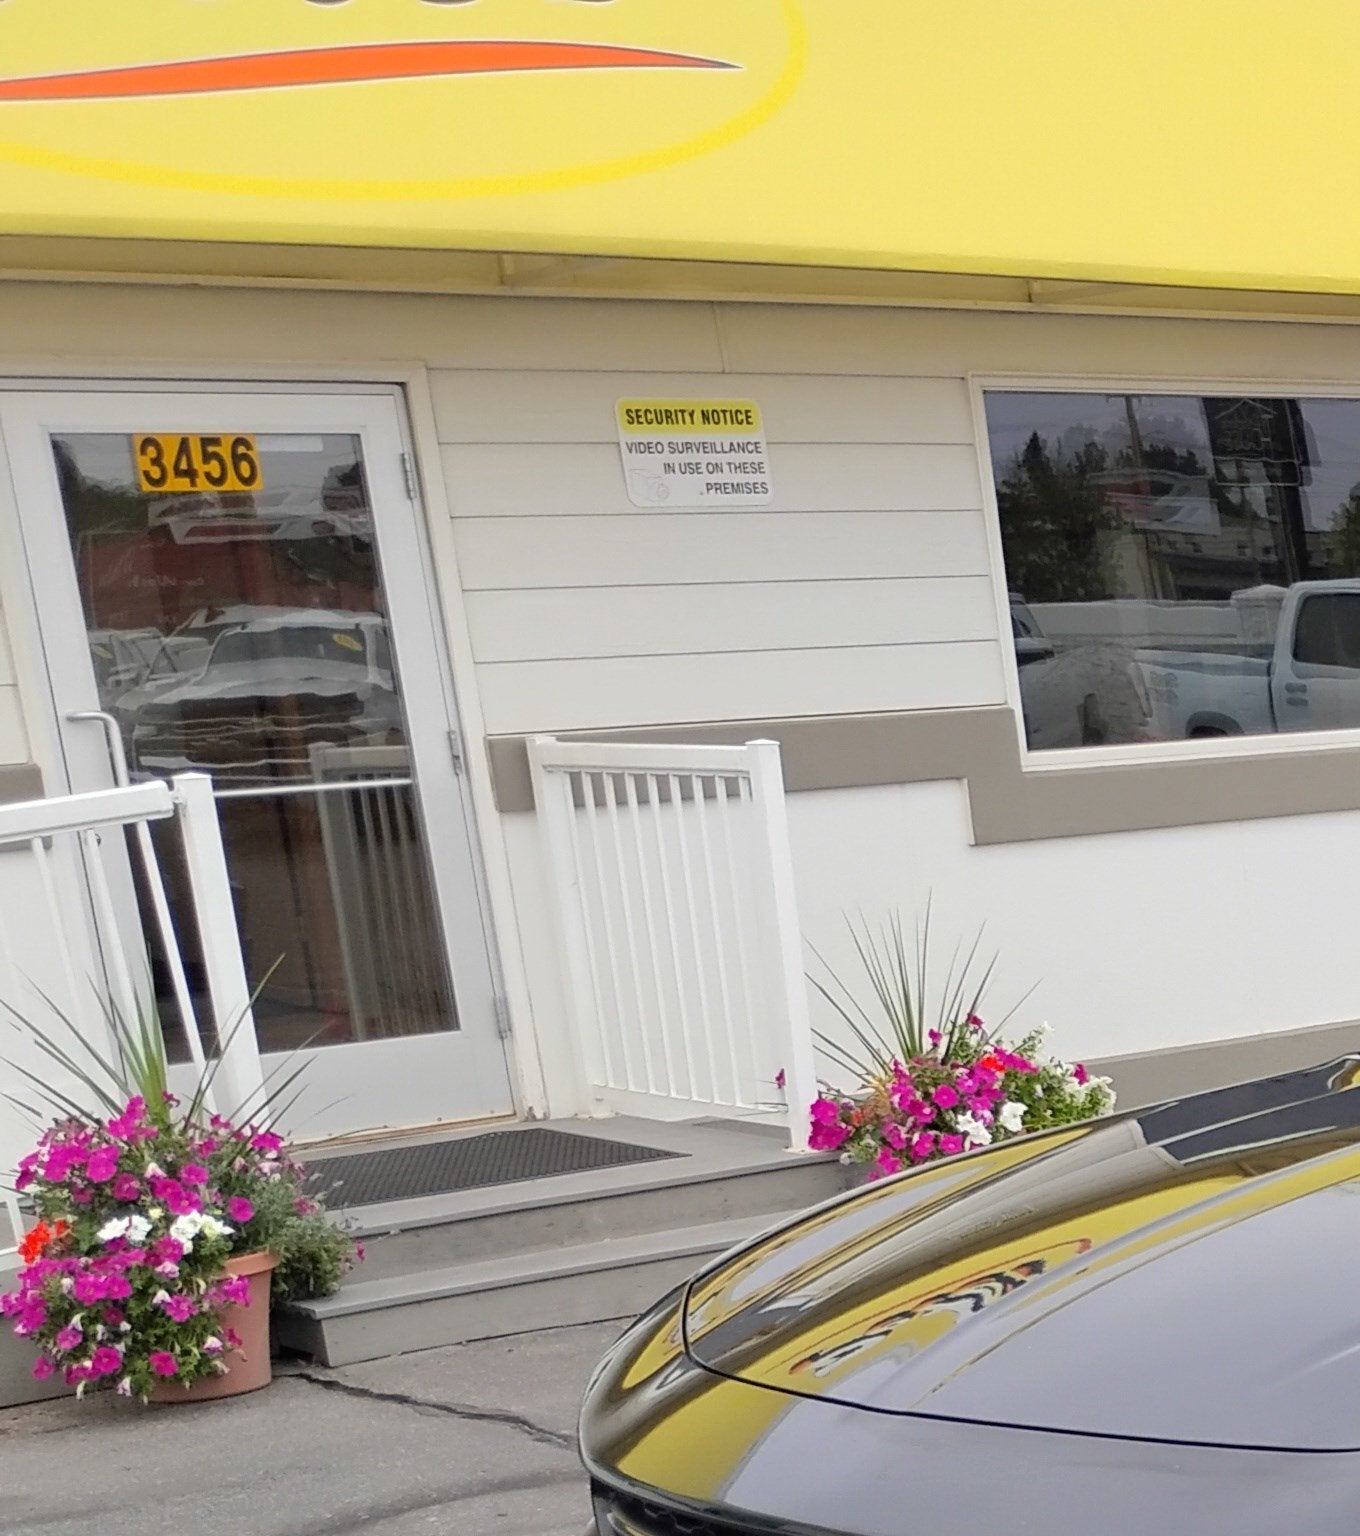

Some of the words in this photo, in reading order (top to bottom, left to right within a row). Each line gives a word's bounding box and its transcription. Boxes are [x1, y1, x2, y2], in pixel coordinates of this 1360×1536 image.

[625, 408, 695, 426] SECURITY
[701, 409, 753, 426] NOTICE
[625, 441, 664, 454] VIDEO
[667, 441, 762, 454] SURVEILLANCE
[140, 436, 258, 488] 3456
[663, 462, 675, 475] IN
[679, 462, 703, 475] USE
[706, 462, 723, 475] ON
[727, 462, 766, 475] THESE
[705, 482, 768, 495] PREMISES
